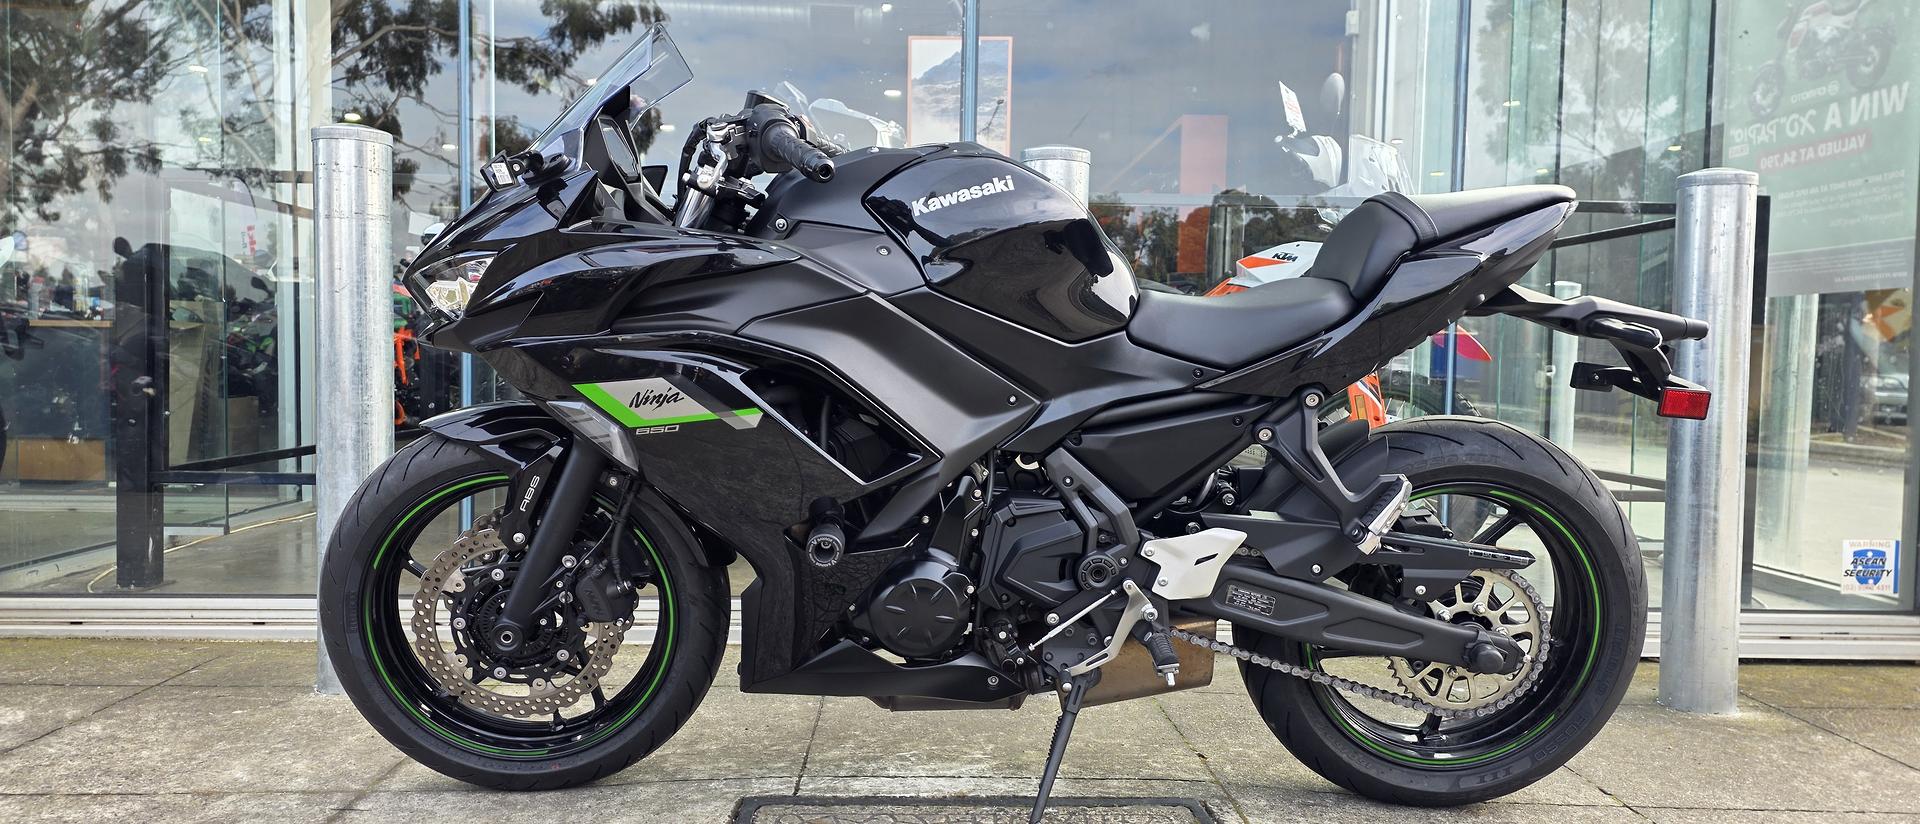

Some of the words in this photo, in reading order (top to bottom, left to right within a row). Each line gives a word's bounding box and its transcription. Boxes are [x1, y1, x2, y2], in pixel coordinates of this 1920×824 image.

[911, 175, 1015, 216] Kawasaki
[1272, 252, 1298, 262] KTM
[628, 387, 684, 411] Ninja
[636, 424, 679, 435] 650
[520, 475, 540, 512] ABS
[1848, 540, 1891, 548] WARNING
[1850, 557, 1886, 565] ASCAN
[1843, 569, 1893, 577] SECURITY
